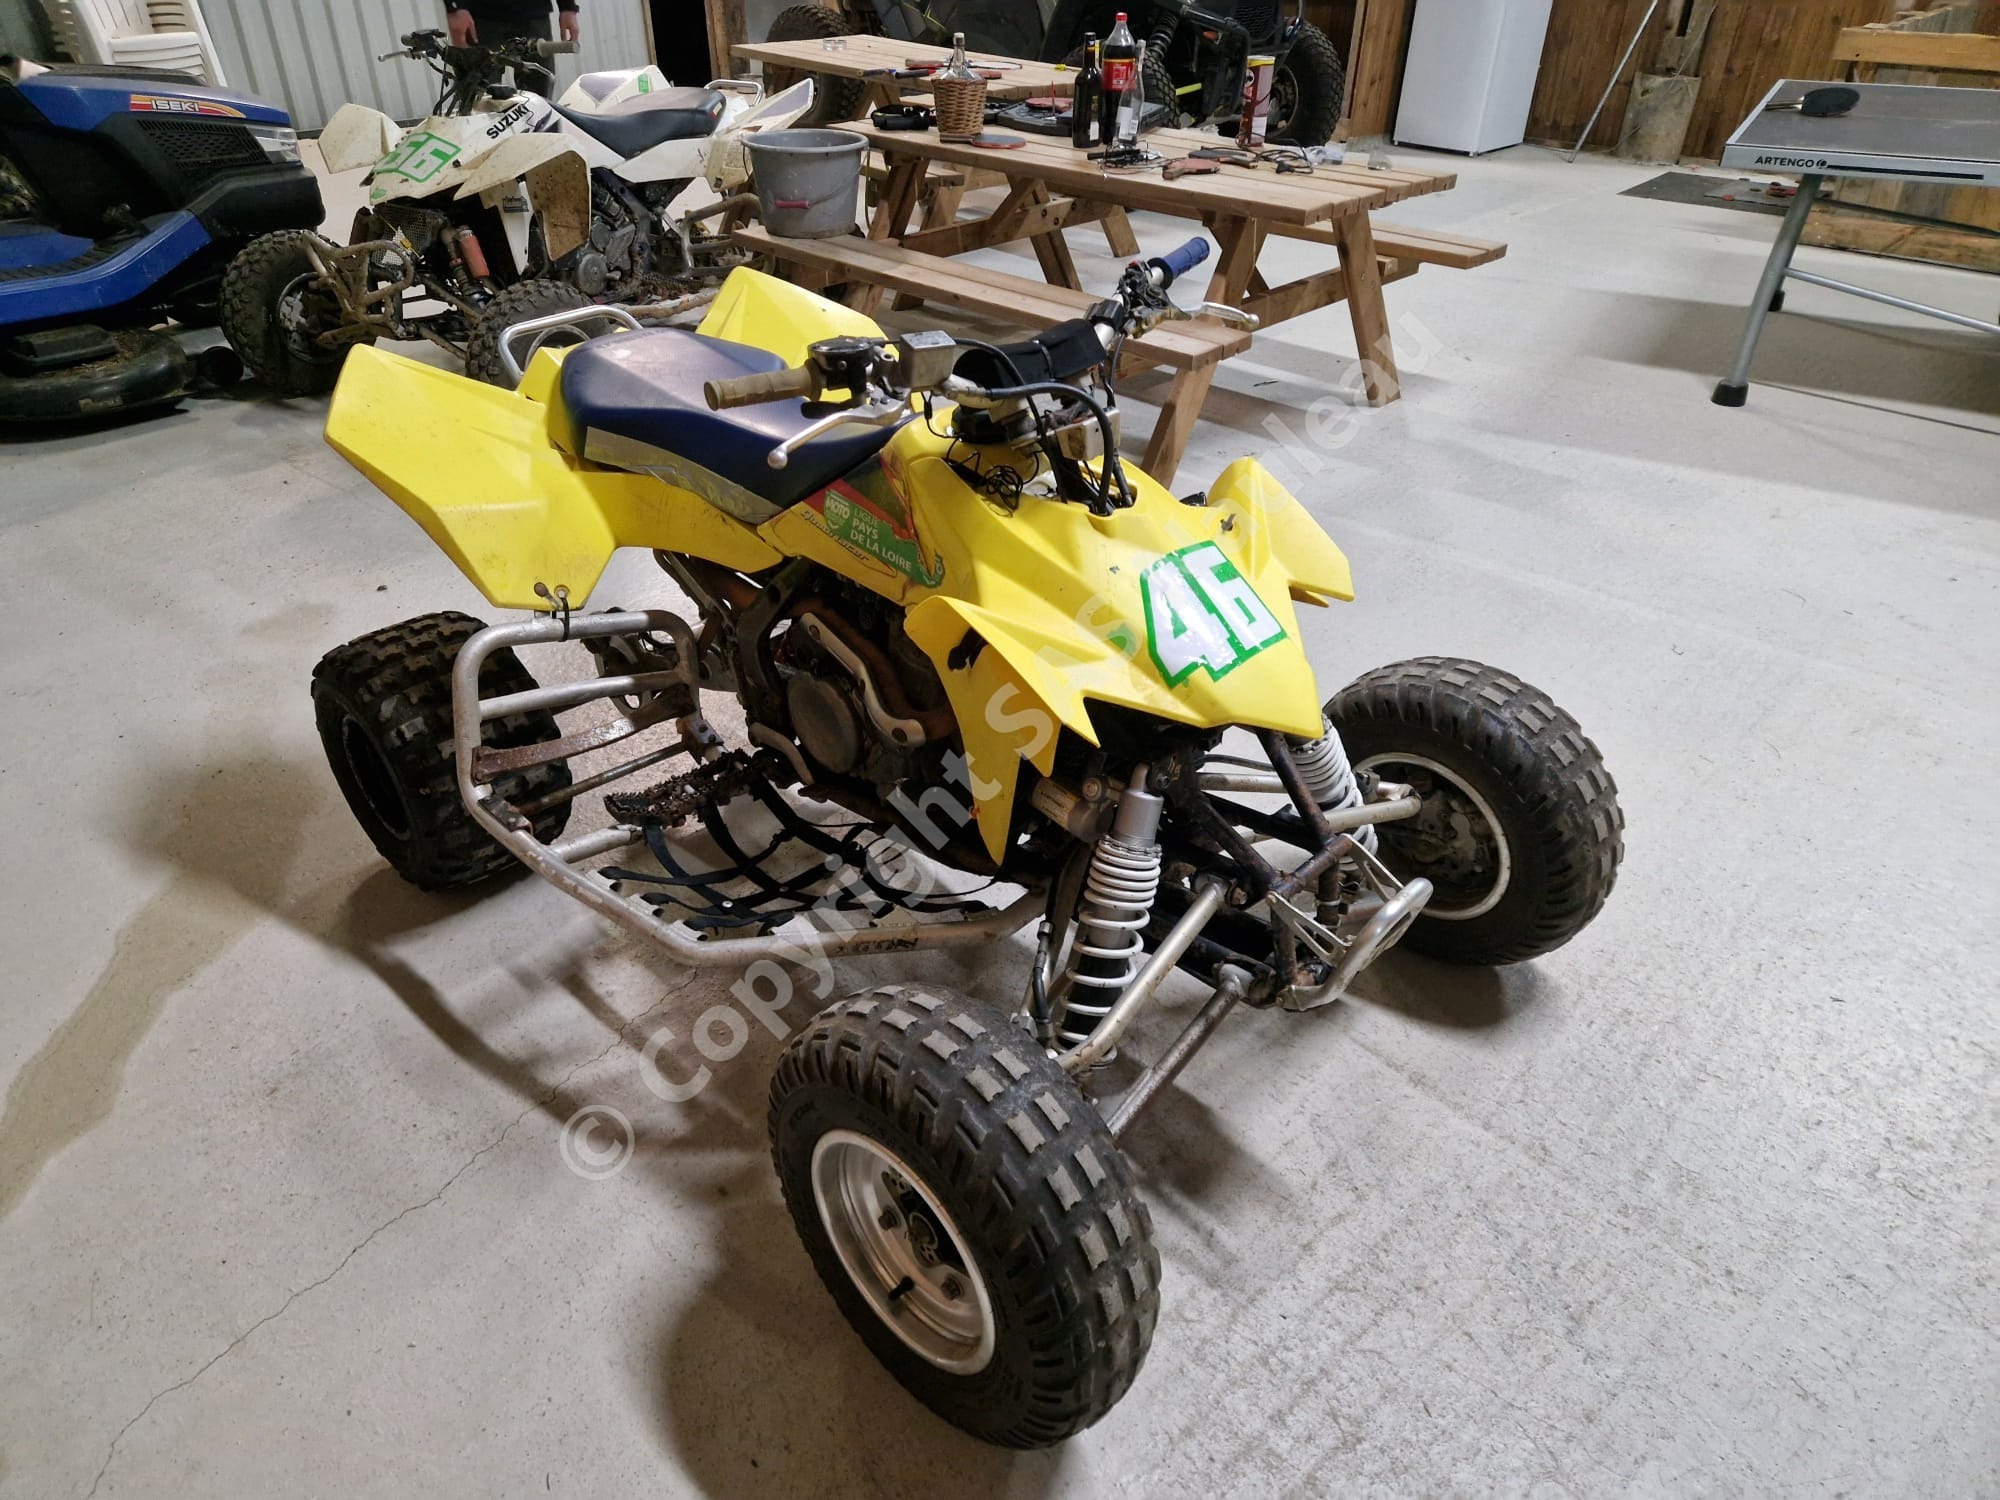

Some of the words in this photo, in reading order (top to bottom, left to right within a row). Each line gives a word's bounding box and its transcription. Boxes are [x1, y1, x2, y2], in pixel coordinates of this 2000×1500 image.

[151, 99, 199, 112] ISEKI
[486, 103, 531, 139] SUZUKI
[1754, 156, 1815, 168] ARTENGO
[826, 496, 850, 519] MOTO
[854, 507, 880, 527] LIGUE
[852, 518, 879, 539] PAYS
[850, 529, 865, 545] DE
[866, 541, 880, 553] LA
[882, 548, 912, 572] LOIRE
[1141, 543, 1286, 684] 46
